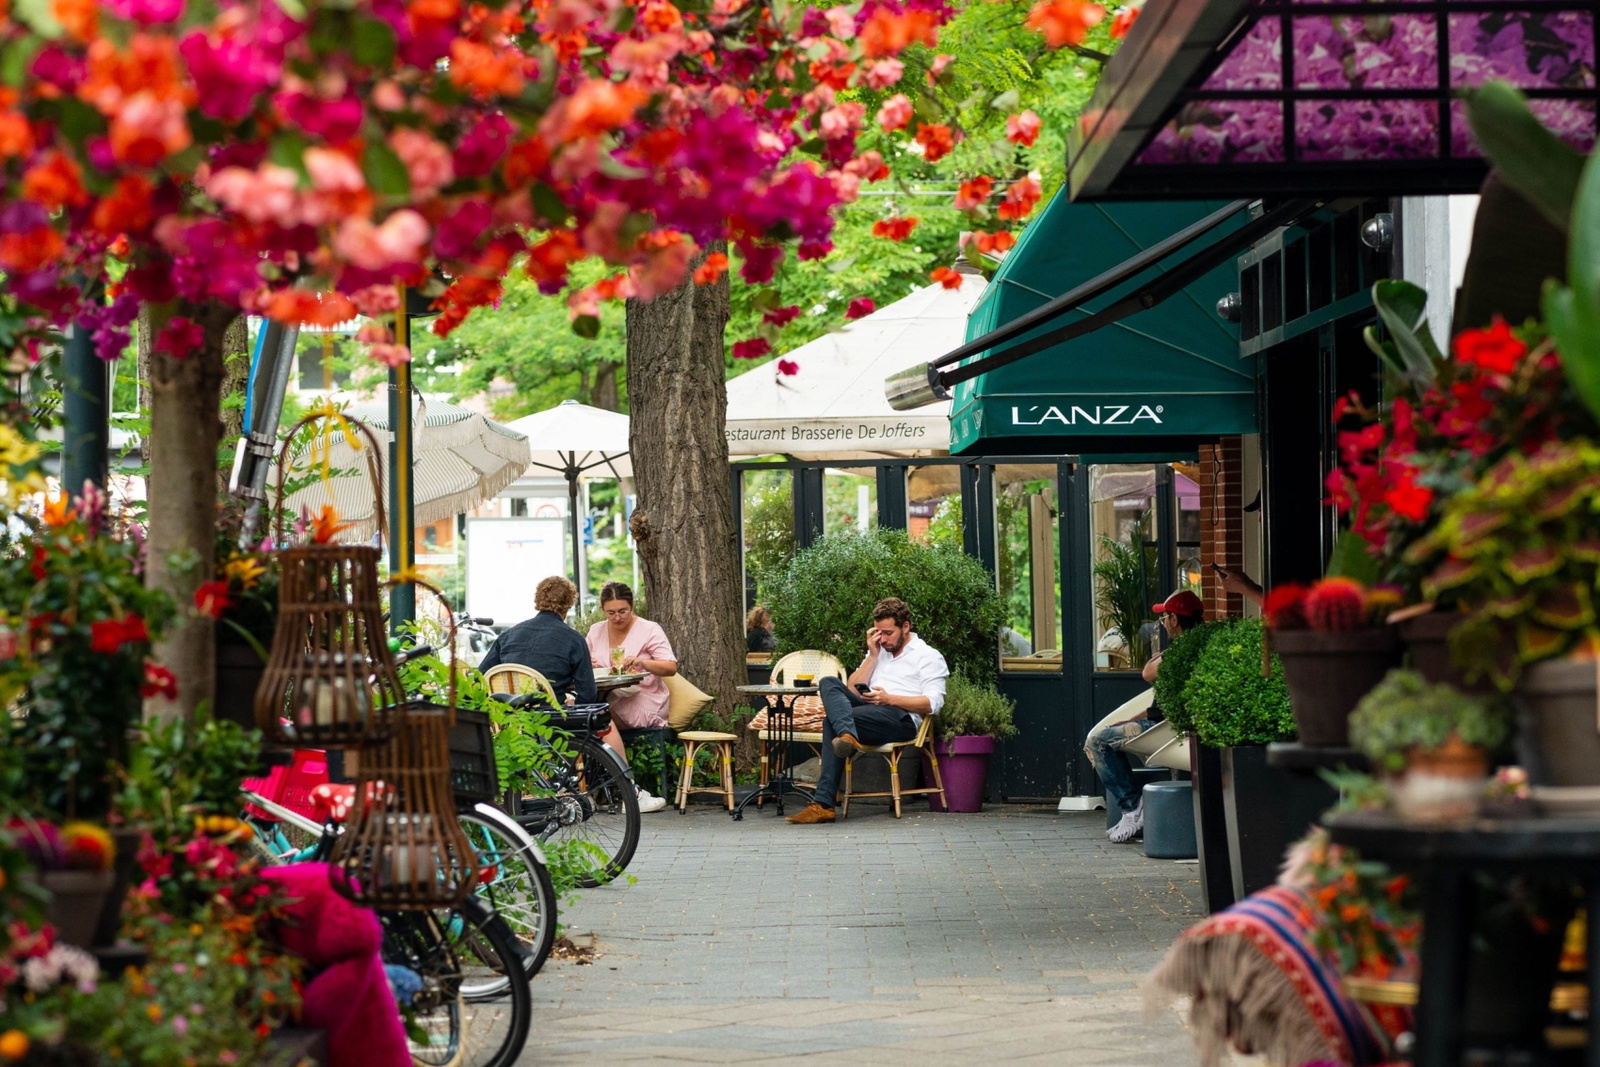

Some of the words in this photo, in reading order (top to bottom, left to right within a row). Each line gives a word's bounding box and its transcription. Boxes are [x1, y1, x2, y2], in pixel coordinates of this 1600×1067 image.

[725, 427, 786, 441] estaurant
[791, 425, 853, 440] Brasserie
[858, 424, 877, 439] De
[880, 422, 926, 438] Joffers
